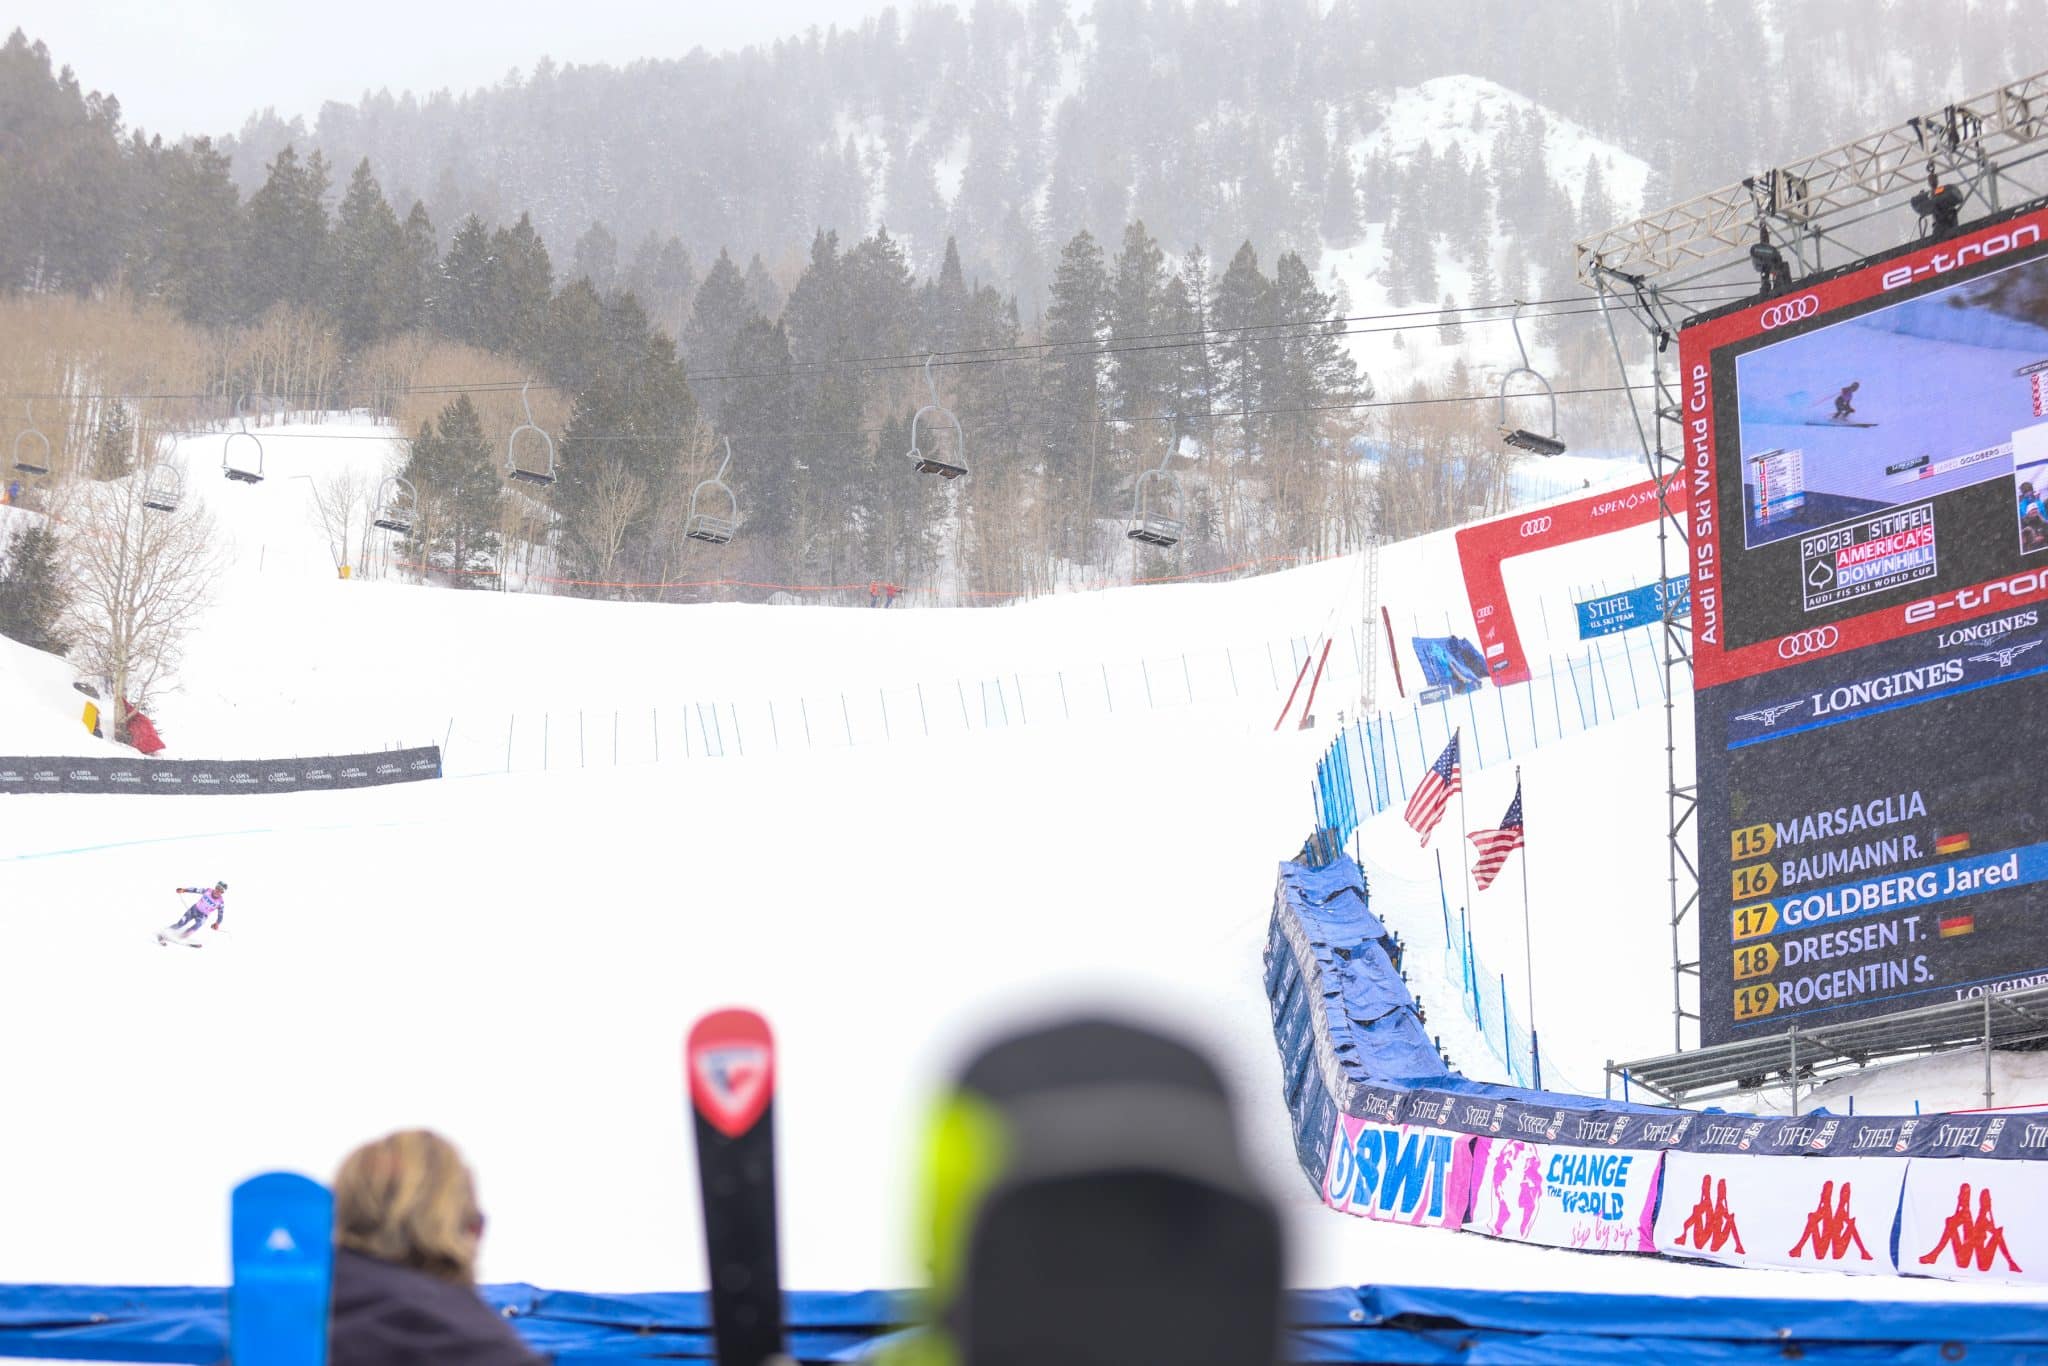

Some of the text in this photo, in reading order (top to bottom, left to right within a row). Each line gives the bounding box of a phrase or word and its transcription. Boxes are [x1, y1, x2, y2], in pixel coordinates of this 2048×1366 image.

[1882, 223, 2040, 290] e-tron
[1591, 499, 1625, 517] ASPEN
[1690, 364, 1717, 644] Audi FIS Ski World Cup
[1804, 509, 1931, 557] 2023 STIFEL
[1837, 527, 1932, 566] AMERICA'S
[1808, 566, 1931, 606] AUDI FIS SKI WORLD CUP
[1838, 548, 1933, 585] DOWNHILL
[1588, 595, 1634, 619] STIFEL
[1938, 610, 2039, 649] LONGINES
[1812, 658, 1965, 717] LONGINES
[1736, 790, 1927, 857] 15 MARSAGLIA
[1737, 834, 1923, 897] 16 BAUMANN R.
[1737, 853, 2019, 936] 17 GOLDBERG Jared
[1737, 916, 1927, 976] 18 DRESSEN T.
[1738, 954, 1934, 1016] 19 ROGENTIN S.
[1352, 1129, 1453, 1217] BWT
[1546, 1153, 1633, 1188] CHANGE
[1547, 1185, 1562, 1198] THE
